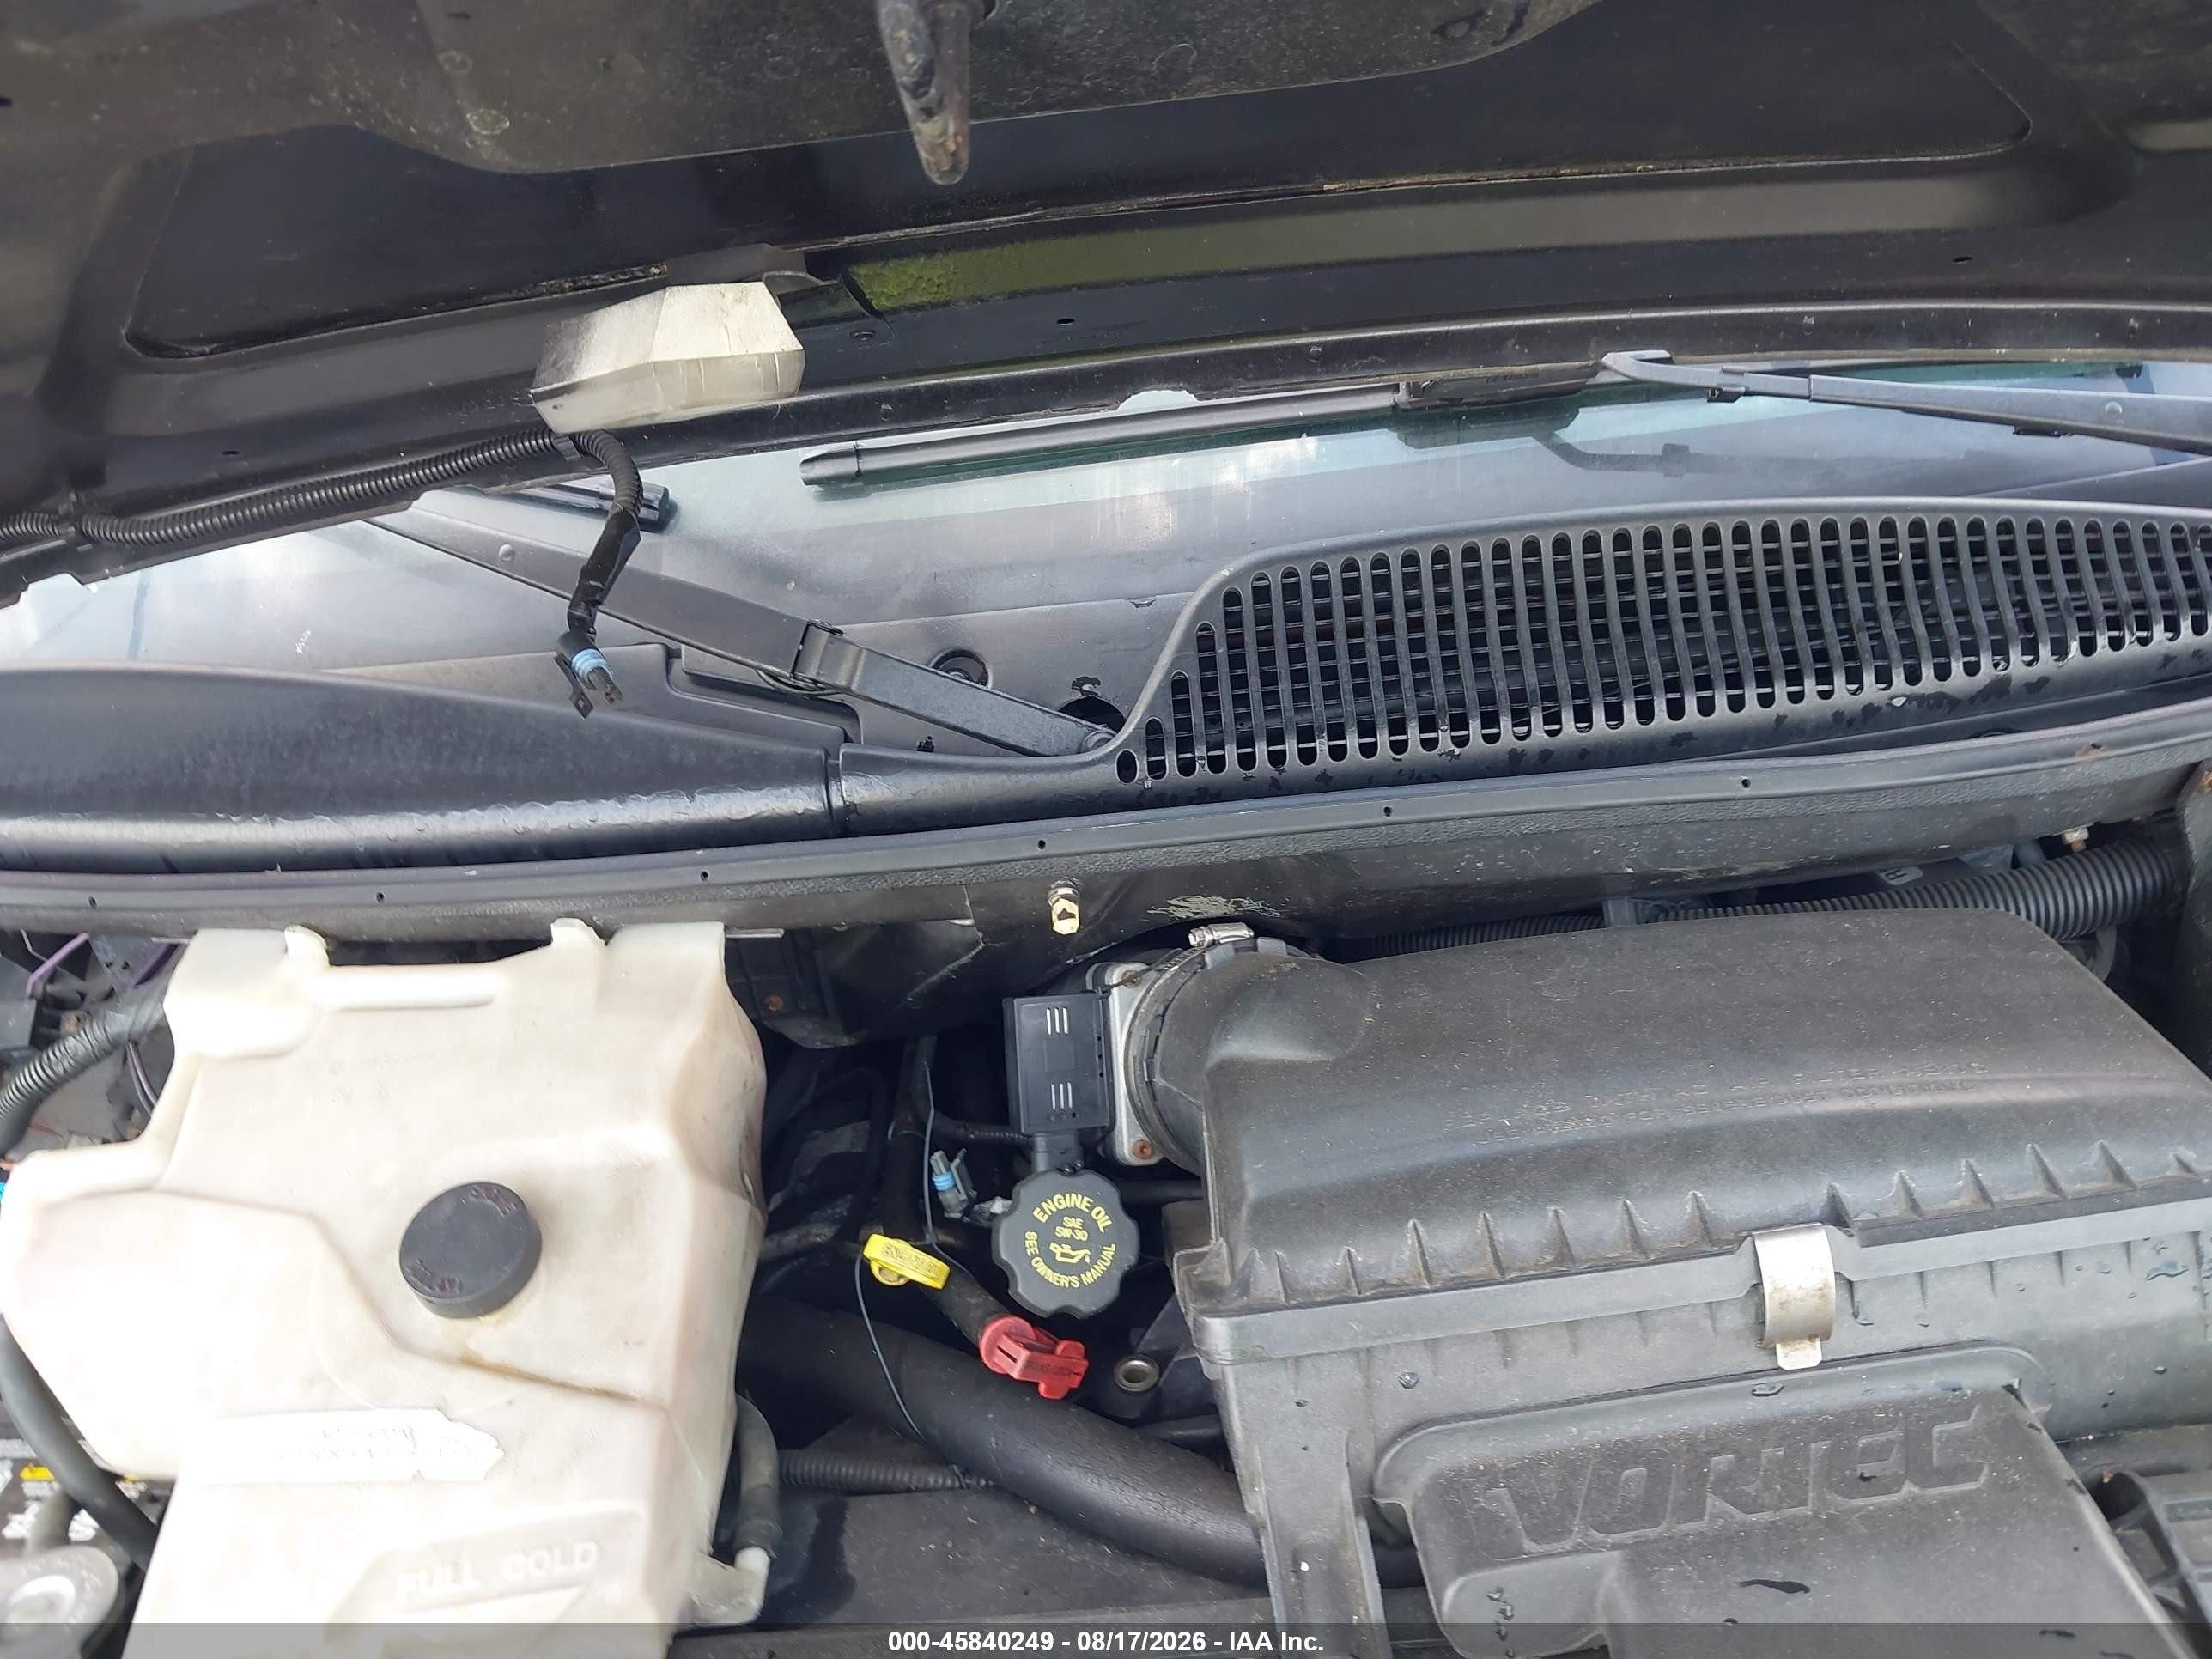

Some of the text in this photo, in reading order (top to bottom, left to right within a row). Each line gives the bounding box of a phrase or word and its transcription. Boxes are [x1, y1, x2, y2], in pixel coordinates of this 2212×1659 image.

[1791, 1067, 1886, 1087] FILTER
[1033, 1193, 1113, 1233] ENGINE OIL
[1062, 1216, 1084, 1229] SAE
[1024, 1231, 1116, 1288] SEE OWNER'S MANUAL
[398, 1539, 599, 1604] FULL COLD
